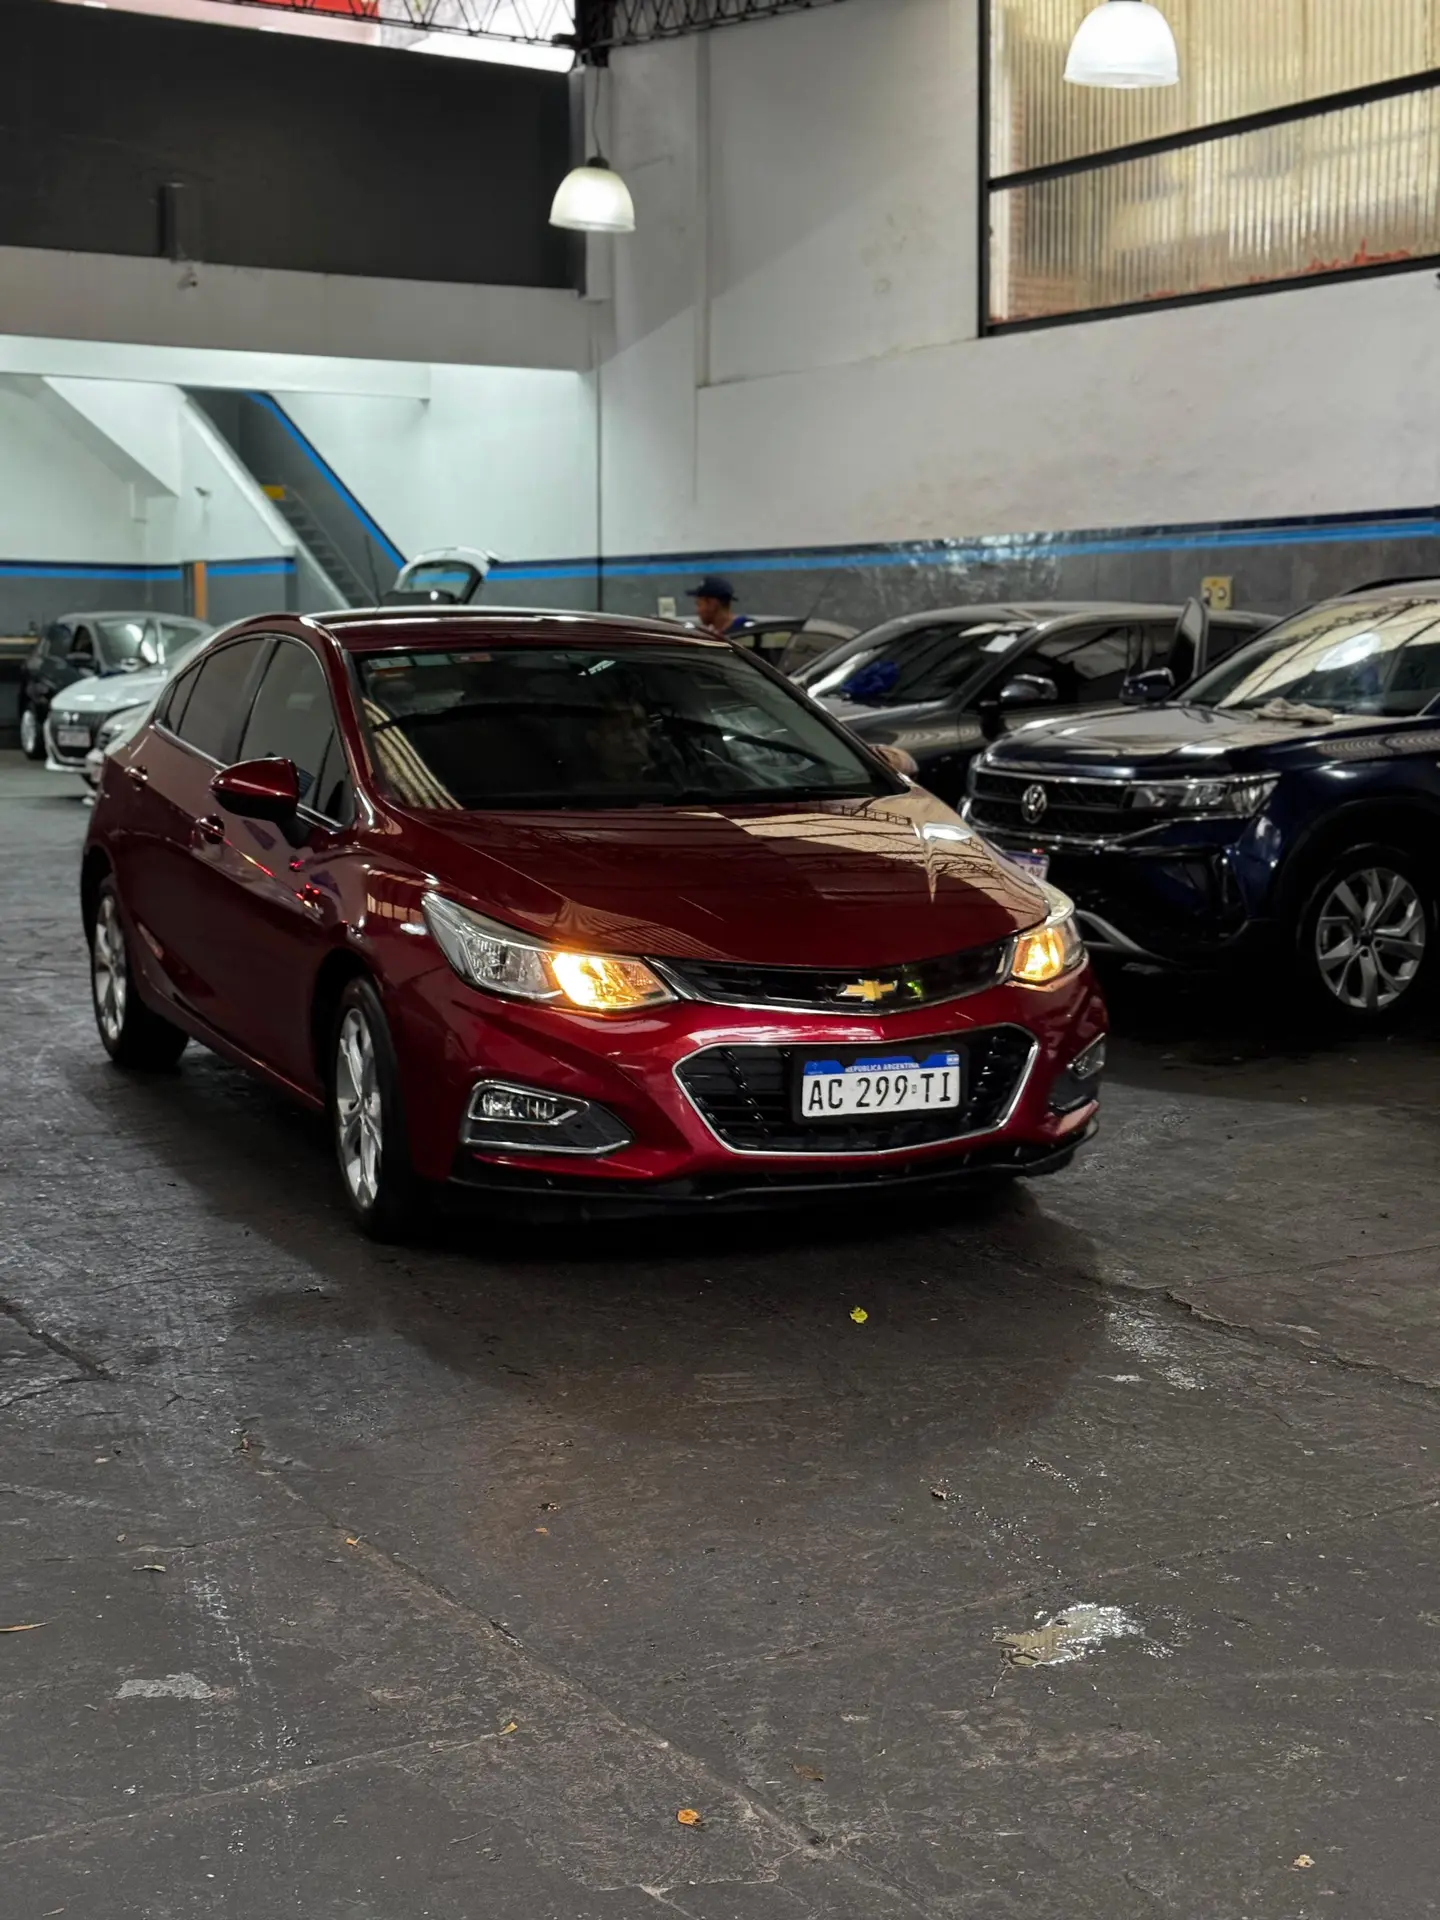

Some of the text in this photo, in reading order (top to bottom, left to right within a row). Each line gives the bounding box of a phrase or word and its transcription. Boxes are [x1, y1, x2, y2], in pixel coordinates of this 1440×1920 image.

[883, 1062, 920, 1071] ARGENTINA
[808, 1072, 951, 1111] AC 299 TI
